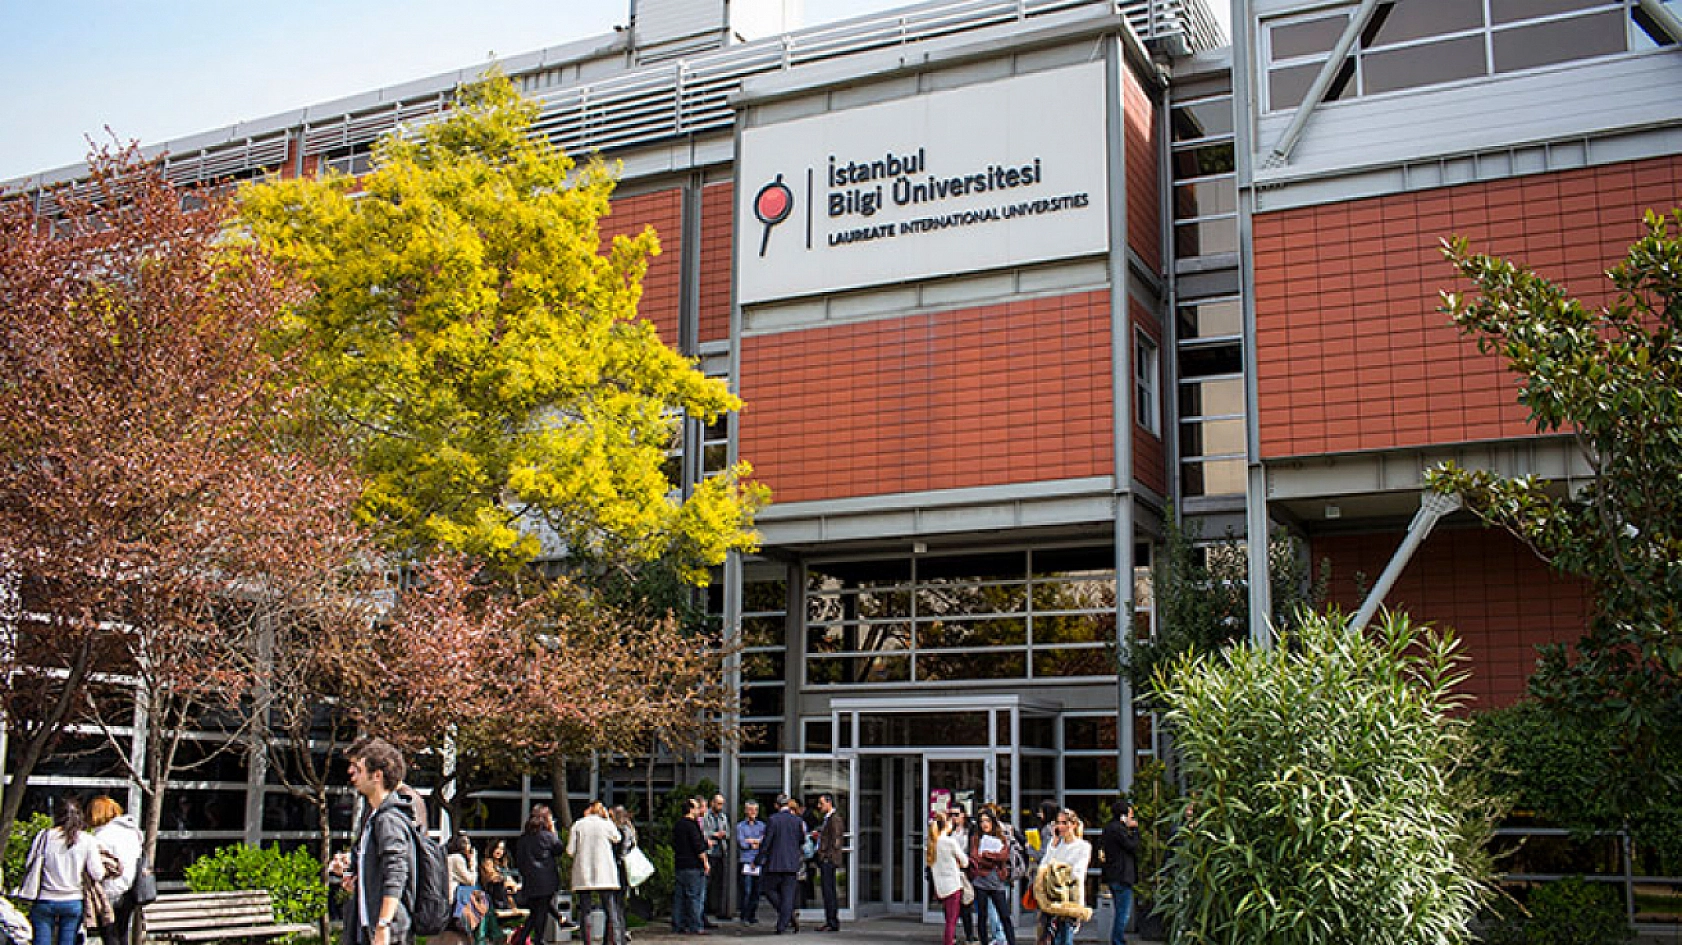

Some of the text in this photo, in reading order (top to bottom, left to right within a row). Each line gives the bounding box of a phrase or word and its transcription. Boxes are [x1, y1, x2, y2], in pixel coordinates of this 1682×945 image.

[827, 157, 1041, 218] Bilgi Üniversitesi
[828, 147, 925, 188] İstanbul
[827, 192, 1089, 247] LAUREATE INTERNATIONAL UNIVERSITIES
